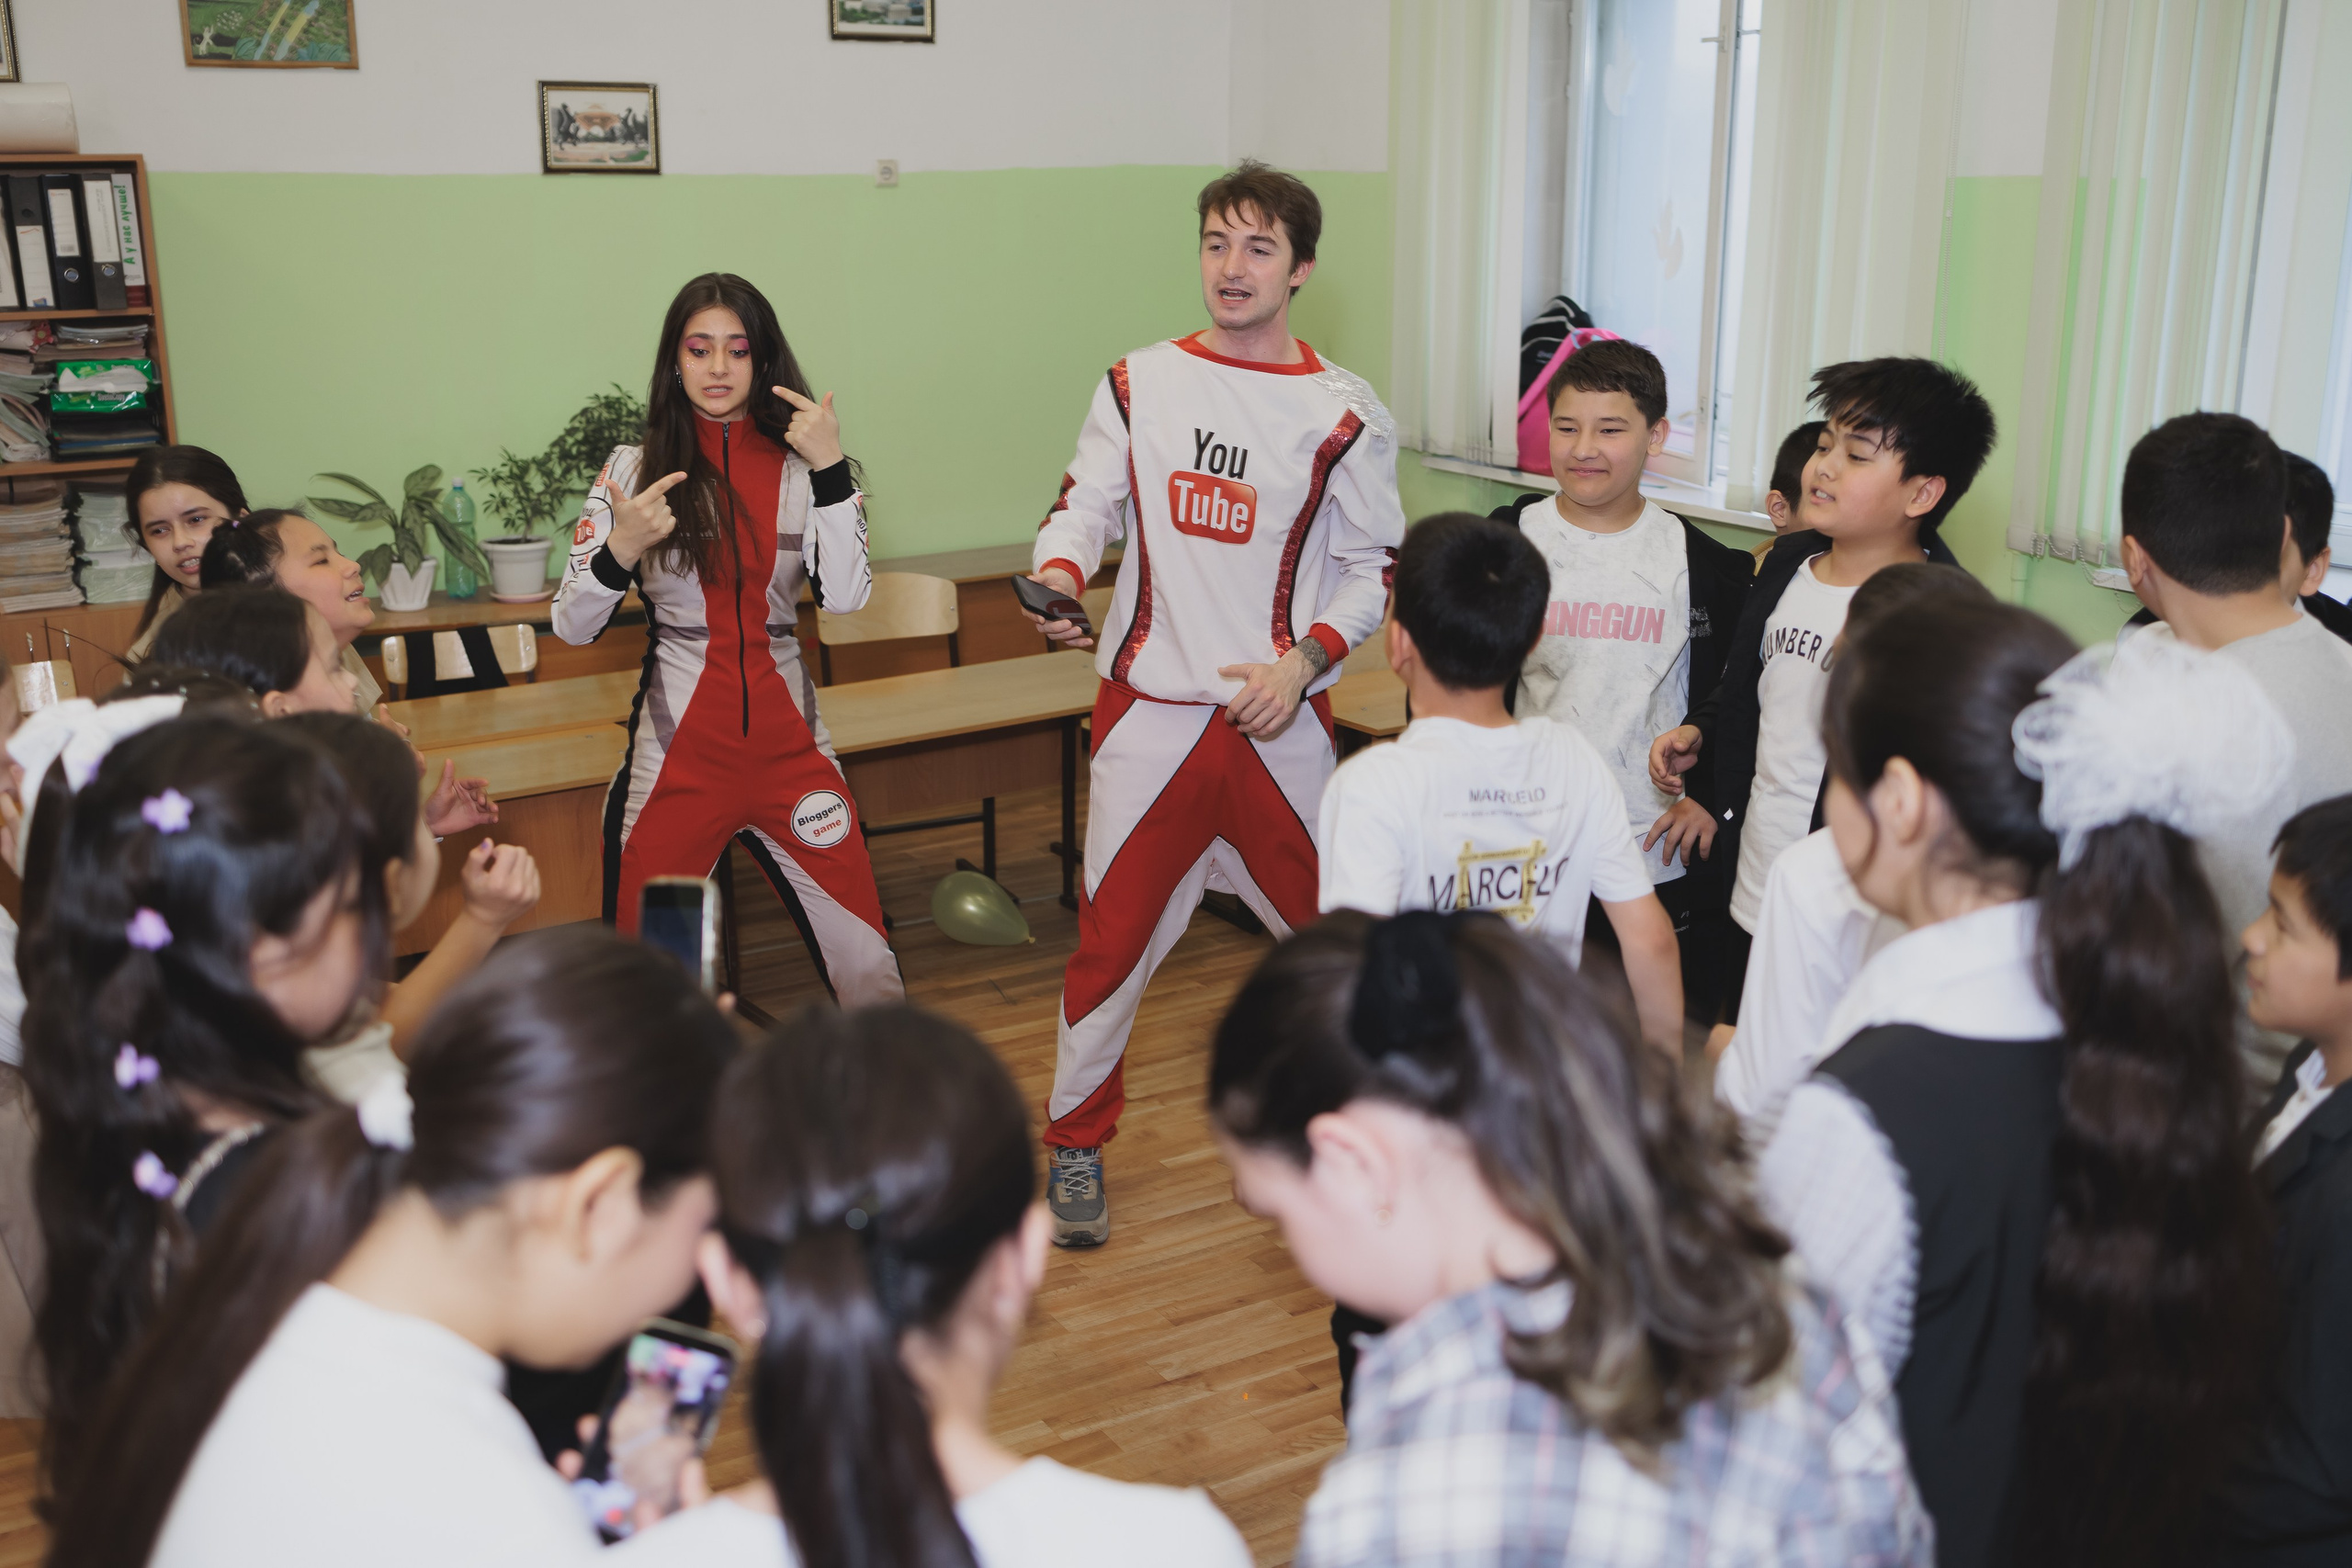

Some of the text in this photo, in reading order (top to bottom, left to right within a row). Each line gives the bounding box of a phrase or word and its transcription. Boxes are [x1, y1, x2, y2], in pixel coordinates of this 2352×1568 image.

[113, 185, 132, 221] лучше!
[122, 225, 132, 243] нас
[1193, 428, 1249, 479] You
[1174, 479, 1249, 534] Tube
[1544, 602, 1666, 644] INGGUN
[797, 803, 842, 827] Bloggers
[813, 819, 842, 837] game
